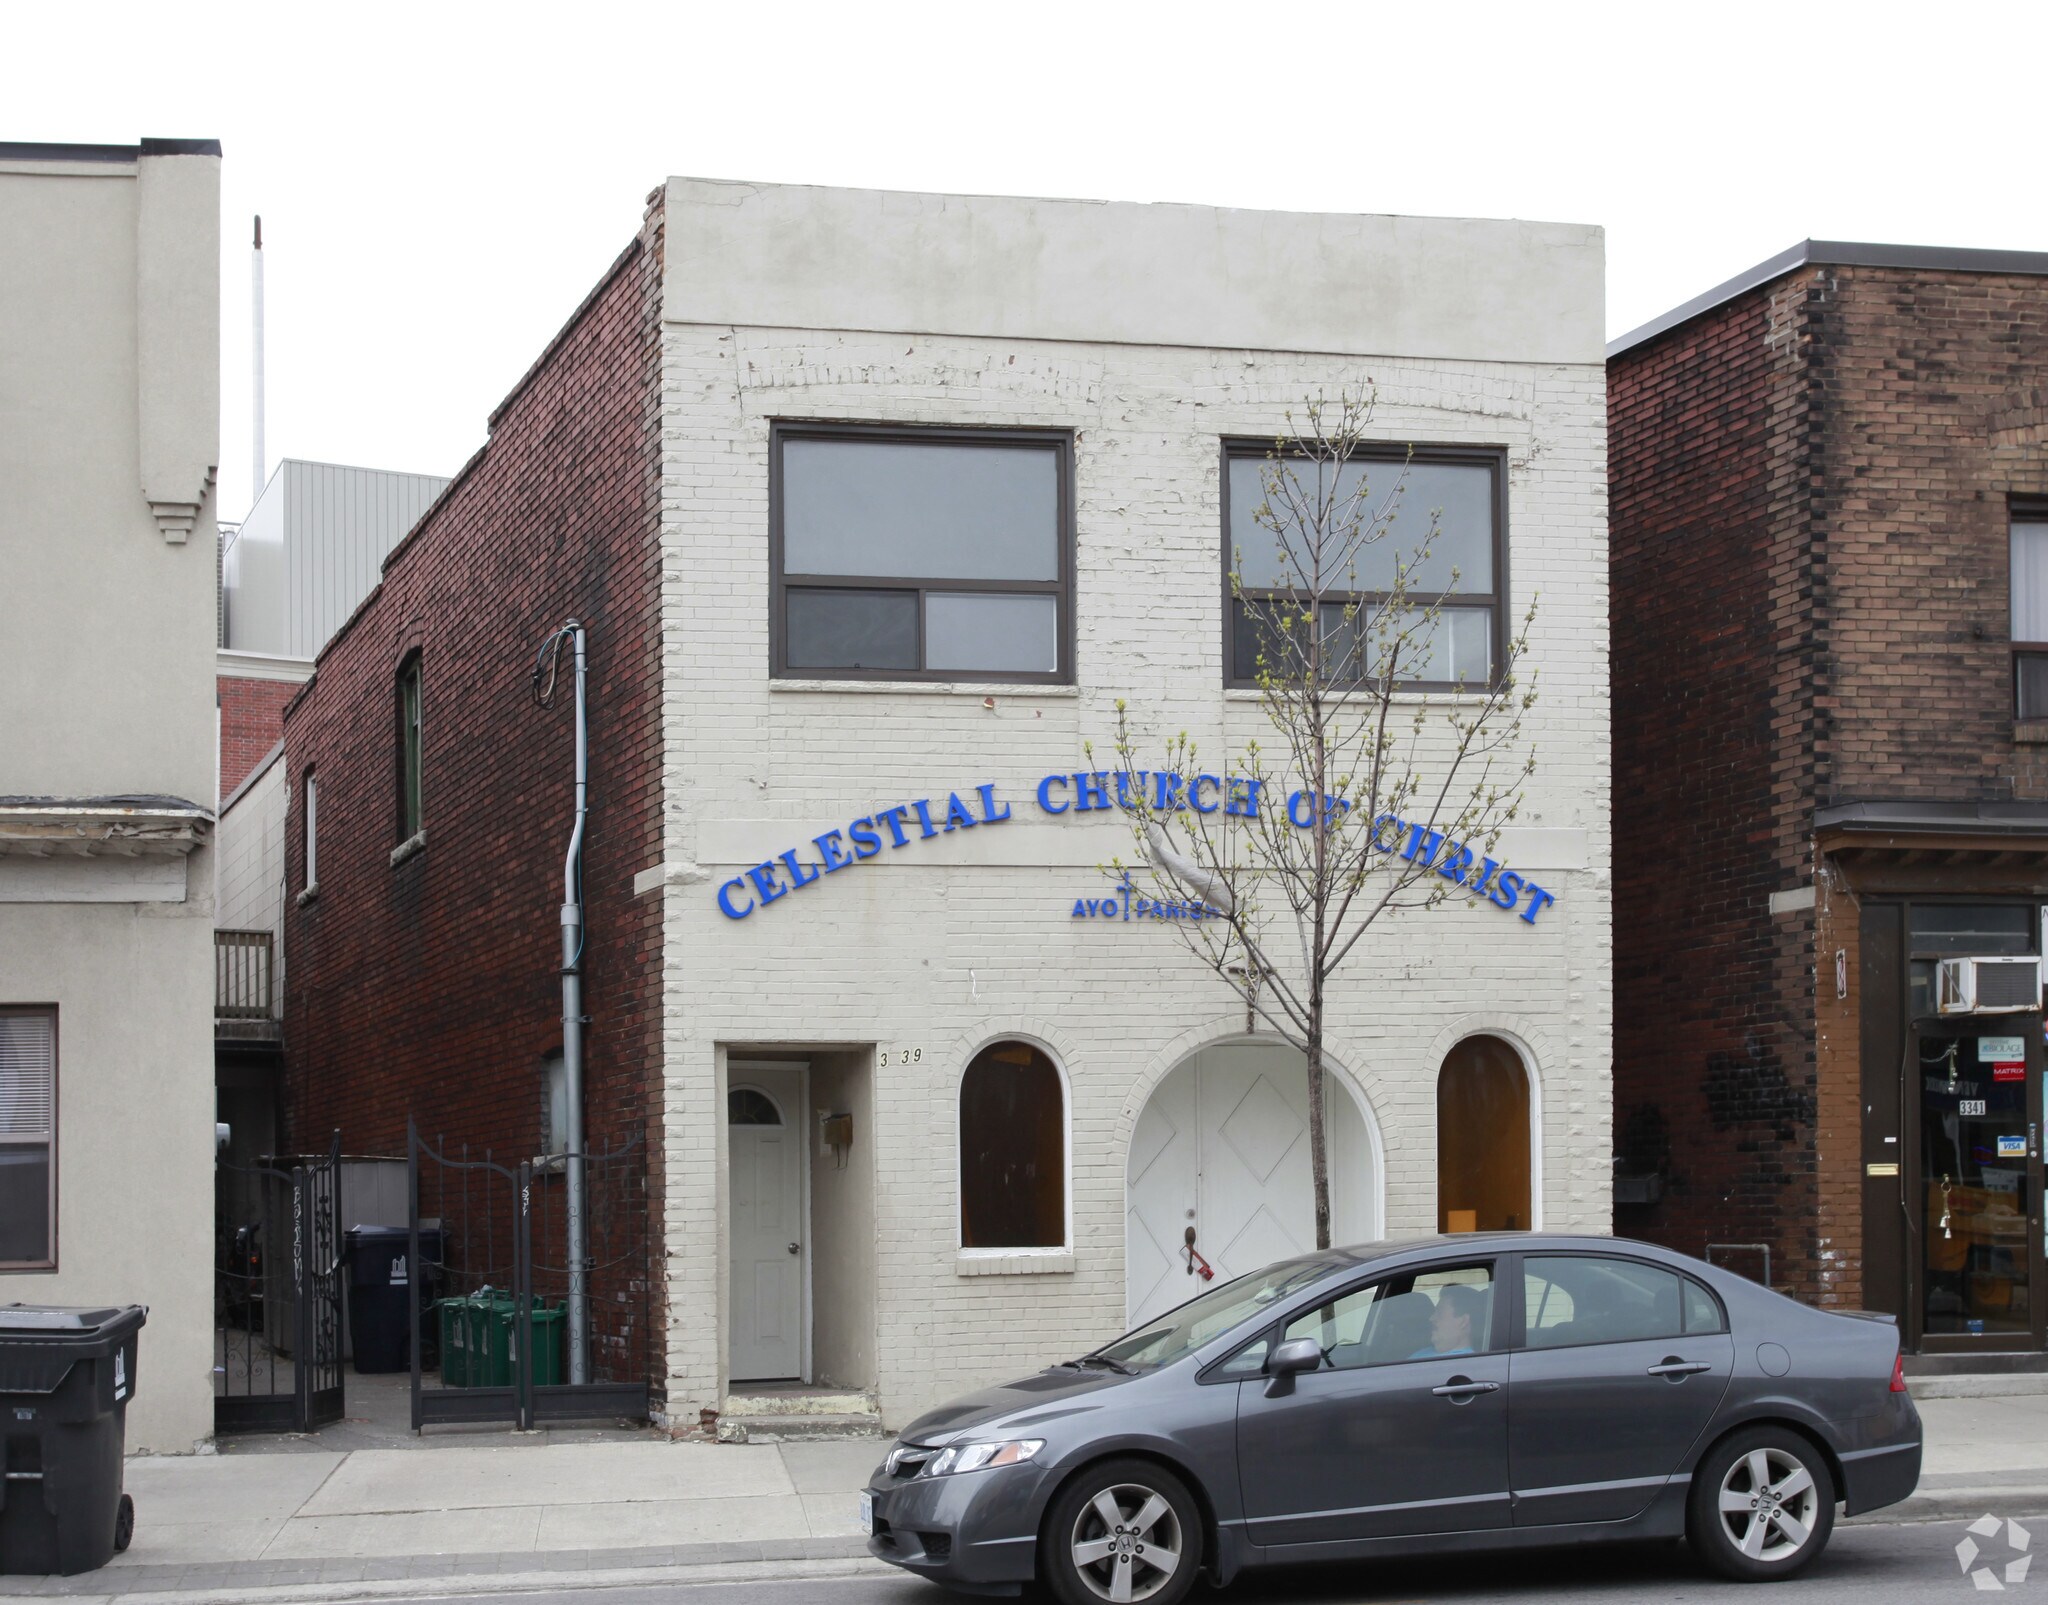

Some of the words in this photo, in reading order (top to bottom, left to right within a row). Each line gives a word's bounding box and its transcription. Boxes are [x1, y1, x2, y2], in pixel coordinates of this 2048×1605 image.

[717, 783, 1011, 919] CELESTIAL
[1037, 771, 1262, 817] CHURCH
[1371, 814, 1555, 925] CHRIST
[1072, 898, 1118, 917] AYO
[1960, 1101, 1985, 1114] 3341
[2003, 1142, 2021, 1150] VISA
